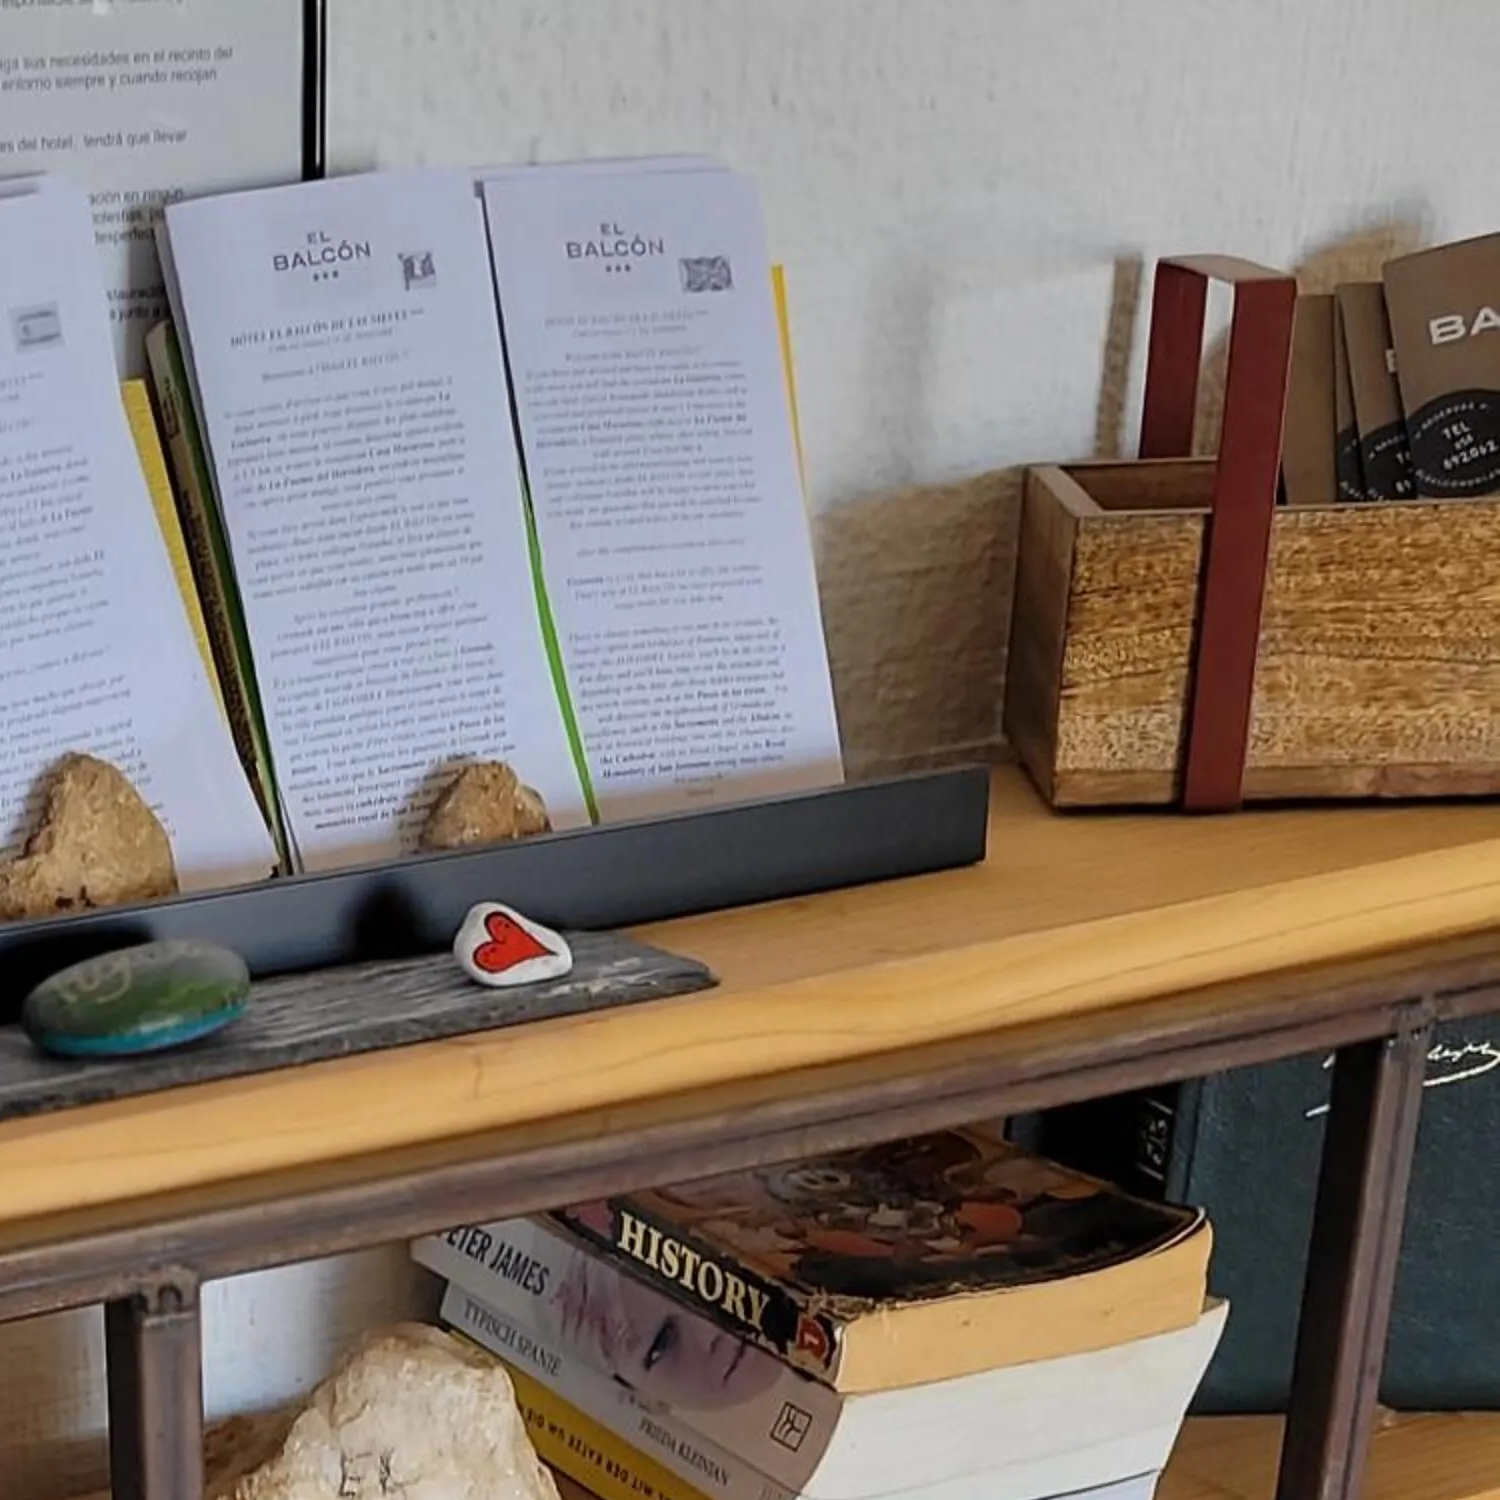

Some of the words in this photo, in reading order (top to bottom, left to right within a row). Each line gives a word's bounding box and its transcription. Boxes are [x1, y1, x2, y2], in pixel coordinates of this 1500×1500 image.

[50, 51, 130, 68] necesidades
[133, 52, 150, 63] en
[153, 50, 165, 62] el
[168, 48, 211, 62] recinto
[214, 46, 233, 60] del
[1, 77, 51, 92] entorno
[54, 75, 104, 91] siempre
[108, 76, 117, 91] y
[119, 69, 167, 86] cuando
[171, 68, 217, 86] recojan
[18, 136, 37, 151] del
[83, 131, 122, 148] tendrá
[126, 131, 150, 149] que
[153, 127, 188, 143] llevar
[307, 230, 331, 245] EL
[600, 223, 624, 236] EL
[273, 240, 371, 271] BALCÓN
[566, 233, 665, 259] BALCÓN
[437, 1224, 493, 1263] ETER
[488, 1241, 551, 1297] JAMES
[616, 1210, 771, 1334] HISTORY
[463, 1298, 518, 1347] TYPISCH
[605, 1459, 629, 1484] DER
[631, 1476, 654, 1498] MIT
